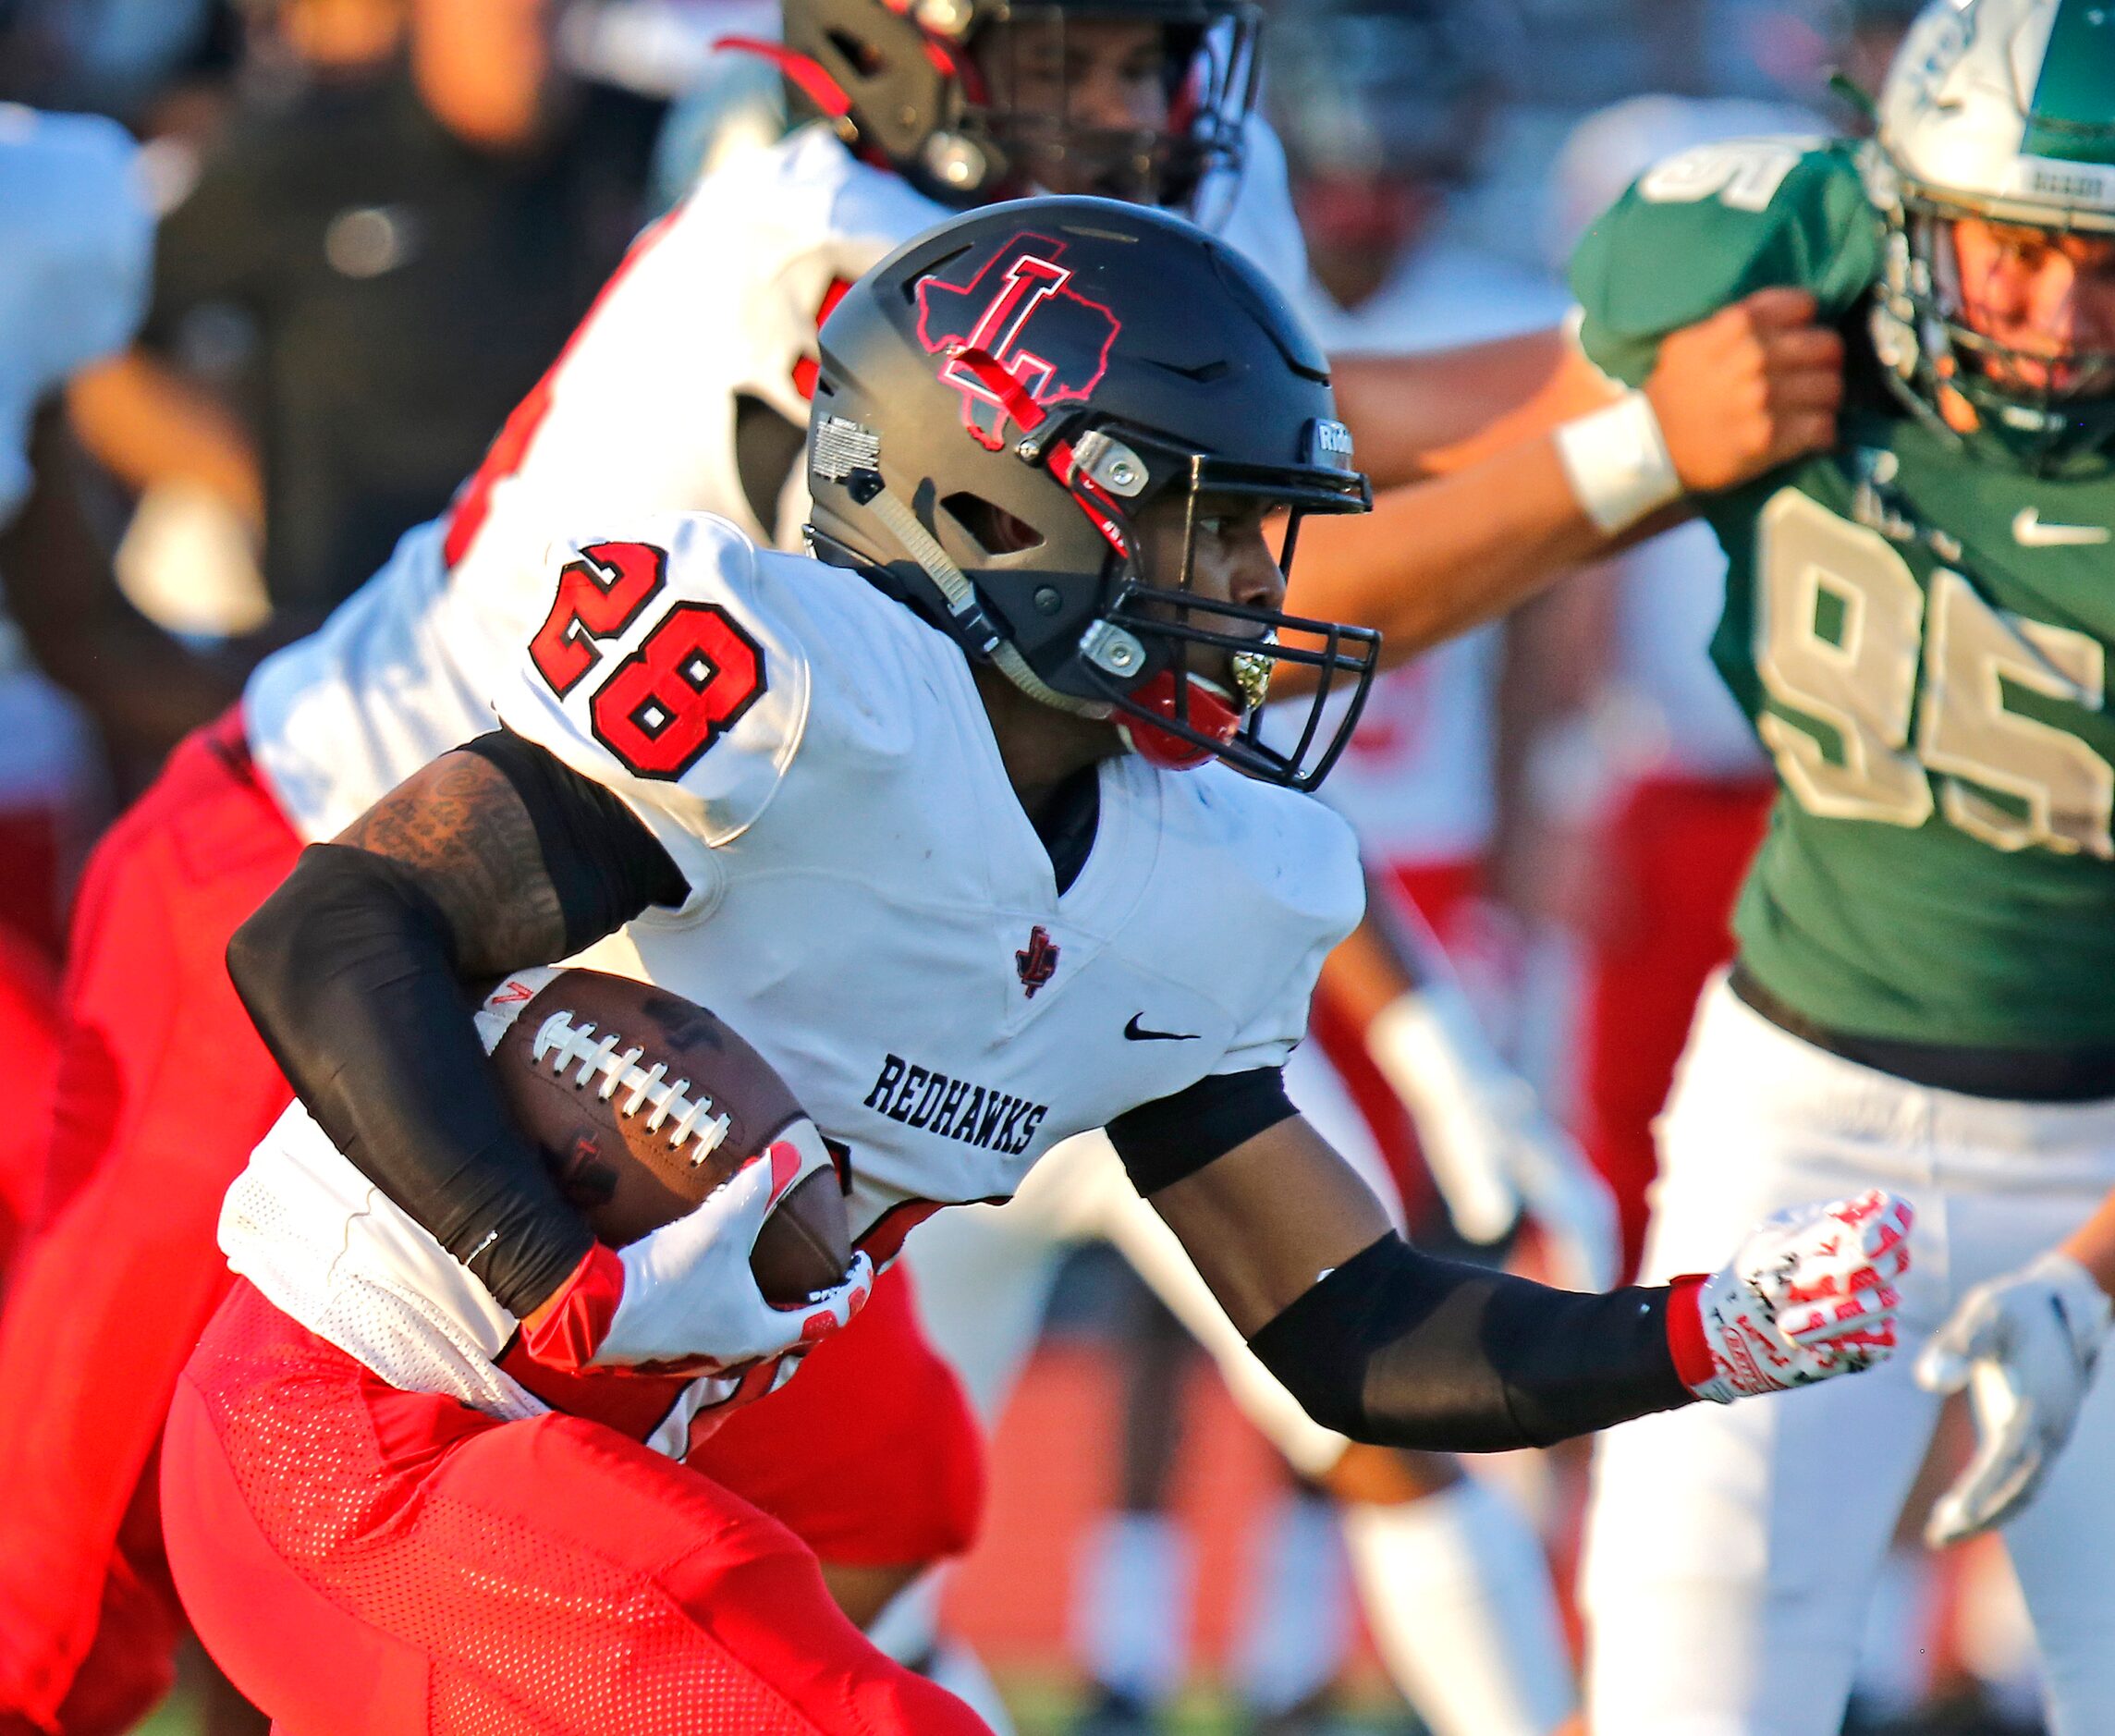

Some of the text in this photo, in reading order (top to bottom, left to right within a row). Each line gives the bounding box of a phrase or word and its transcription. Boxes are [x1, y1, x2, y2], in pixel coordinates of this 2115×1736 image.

[528, 541, 768, 782] 28
[1754, 486, 2115, 861] 95
[863, 1053, 1048, 1155] REDHAWKS
